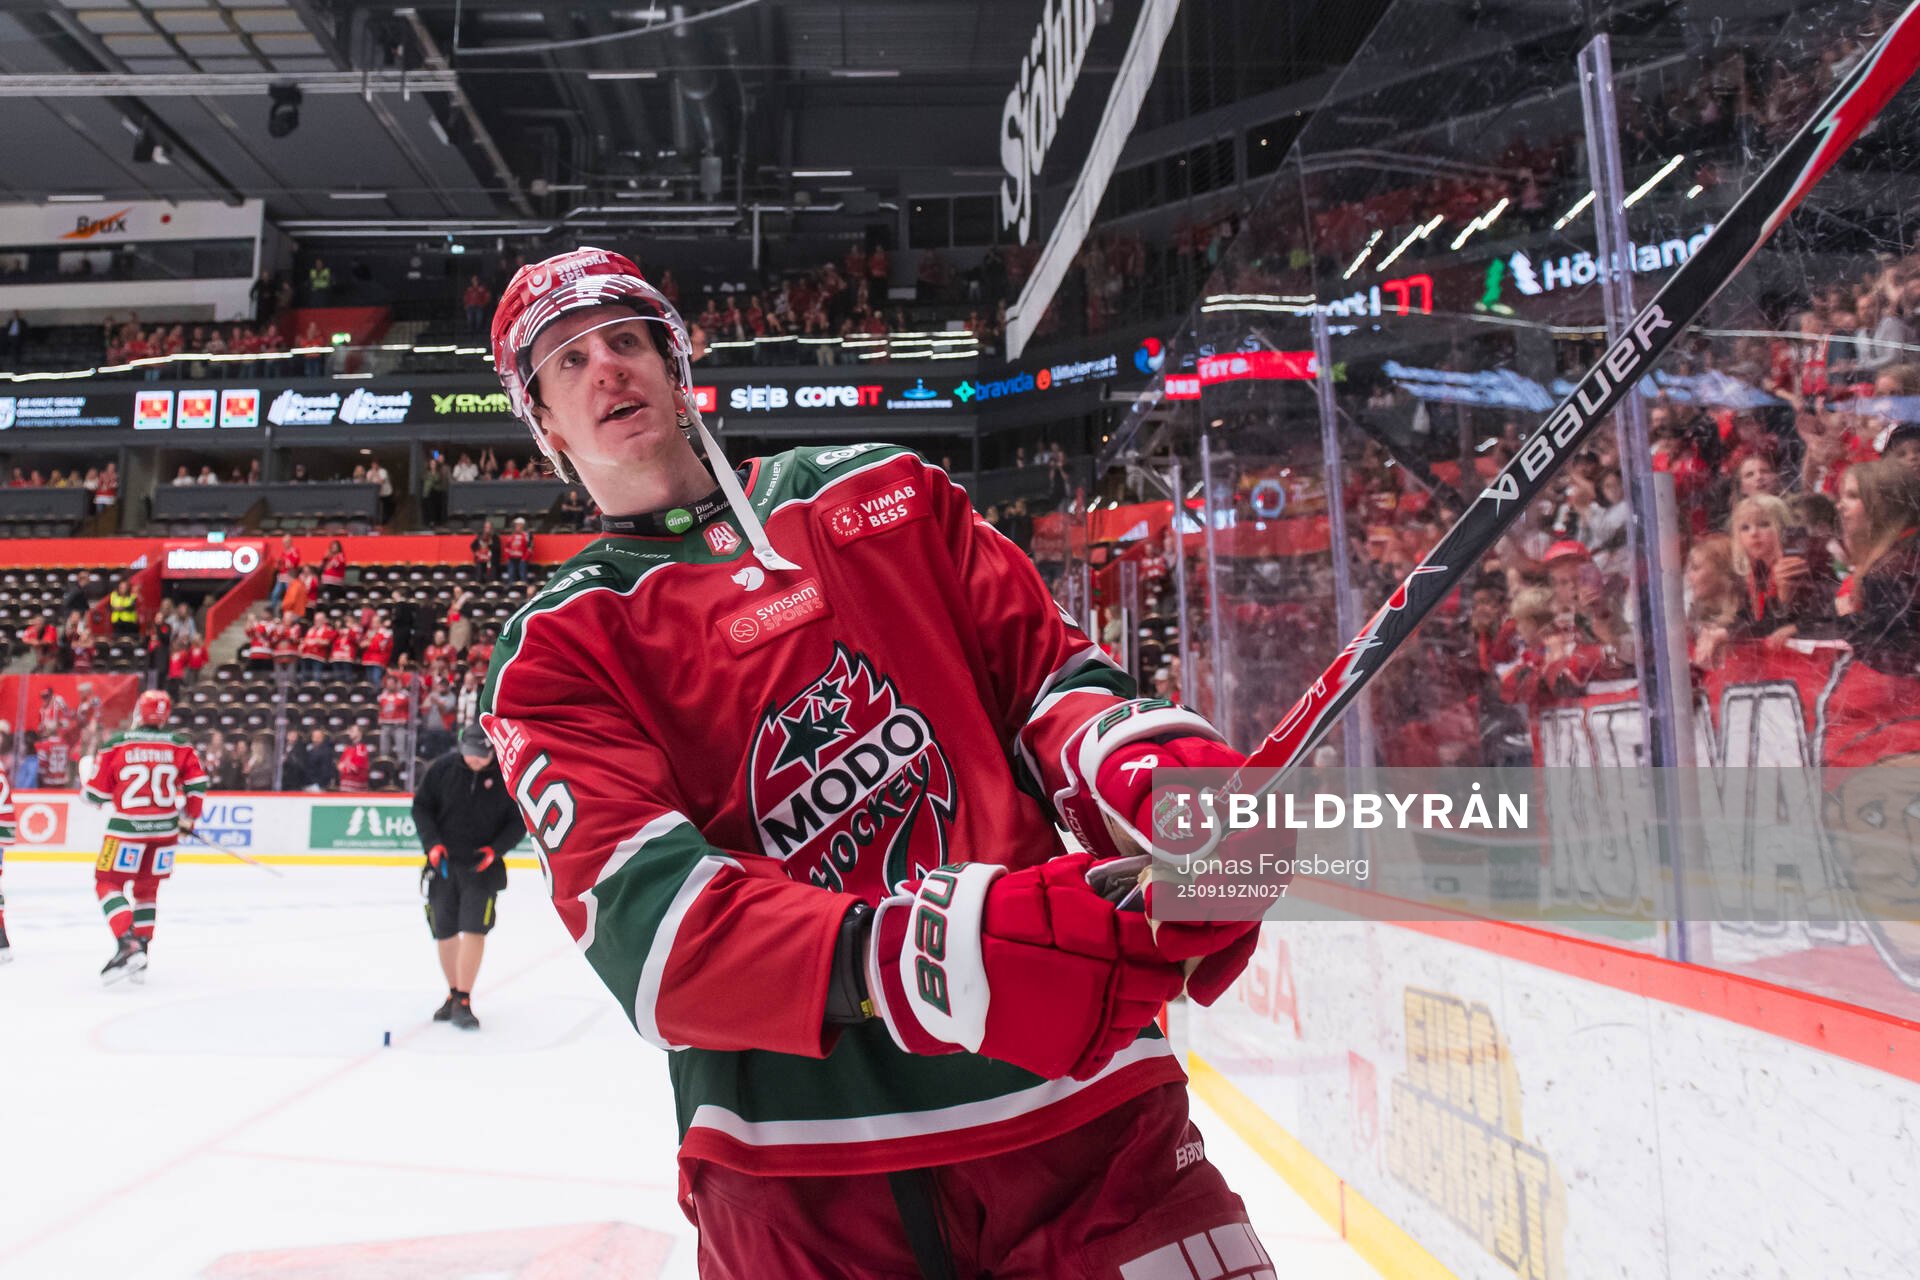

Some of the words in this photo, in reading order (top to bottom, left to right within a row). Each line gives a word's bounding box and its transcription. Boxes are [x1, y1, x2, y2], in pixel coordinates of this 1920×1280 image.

[555, 254, 610, 275] SVENSKA
[559, 267, 587, 286] SPEL
[730, 385, 788, 412] SEB
[795, 385, 883, 408] coreIT
[975, 370, 1034, 401] bravida
[695, 501, 714, 515] Dina
[860, 485, 916, 514] VIMAB
[667, 515, 690, 527] dina
[869, 504, 908, 528] BESS
[756, 586, 818, 621] SYNSAM
[763, 596, 825, 631] SPORTS
[119, 763, 179, 809] 20
[760, 714, 925, 857] MODO
[809, 749, 931, 893] HOCKEY
